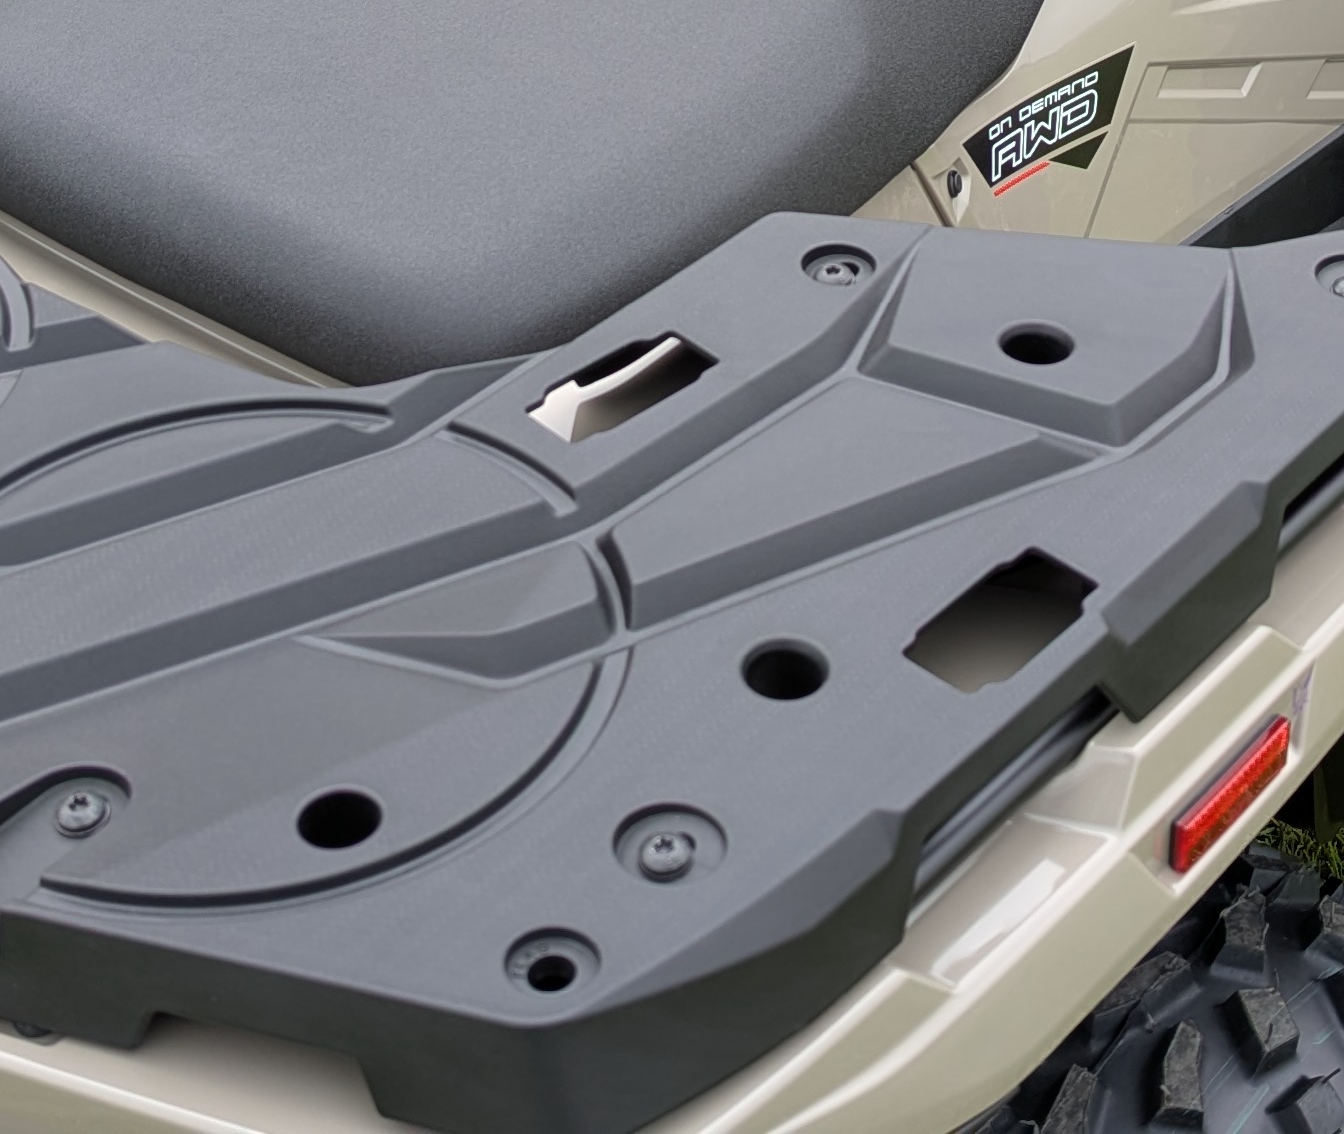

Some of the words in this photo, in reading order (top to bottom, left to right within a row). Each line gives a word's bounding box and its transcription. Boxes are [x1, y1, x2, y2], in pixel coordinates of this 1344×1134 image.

[988, 116, 1012, 140] ON
[1019, 71, 1099, 121] DEMAND
[992, 89, 1098, 182] AWD
